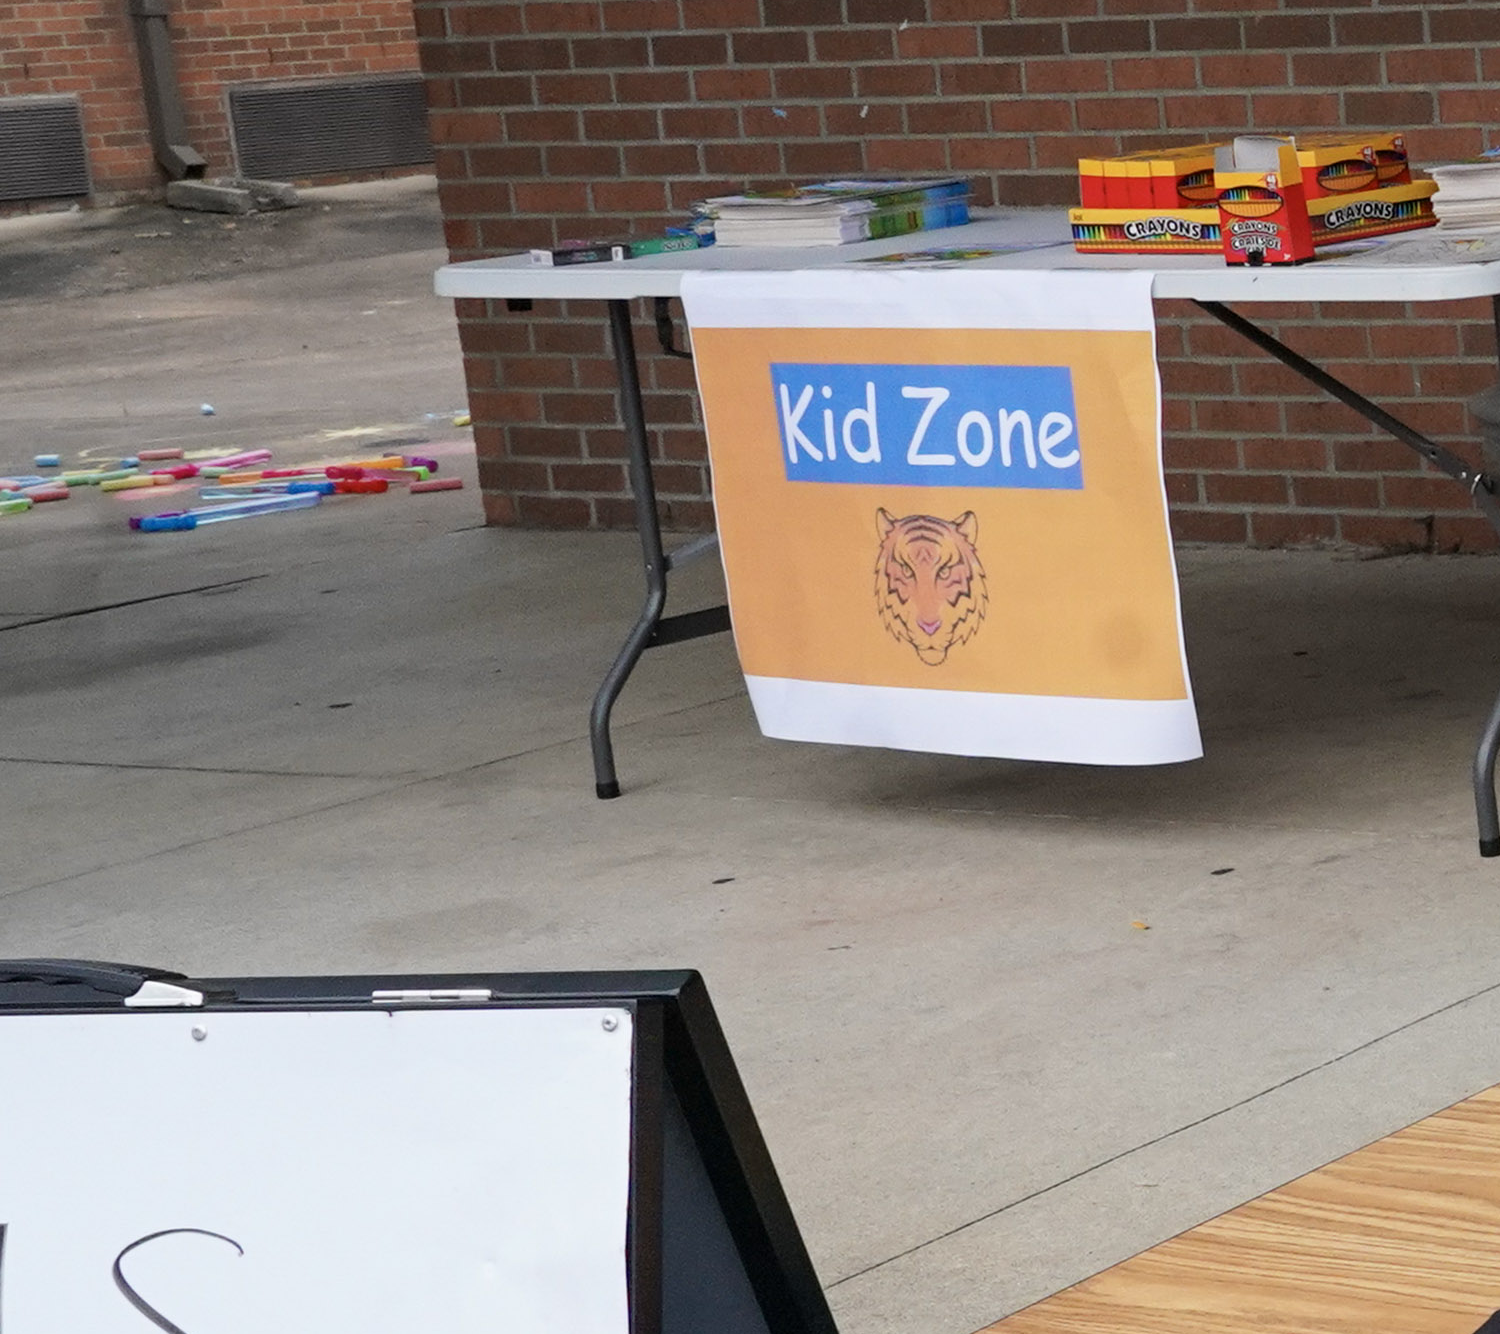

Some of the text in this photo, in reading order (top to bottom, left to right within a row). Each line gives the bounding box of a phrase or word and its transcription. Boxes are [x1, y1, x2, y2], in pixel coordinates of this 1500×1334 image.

[1230, 220, 1278, 235] CRAYONS
[1324, 201, 1394, 230] CRAYONS
[1123, 217, 1202, 241] CRAYONS
[779, 382, 1080, 470] Kid Zone
